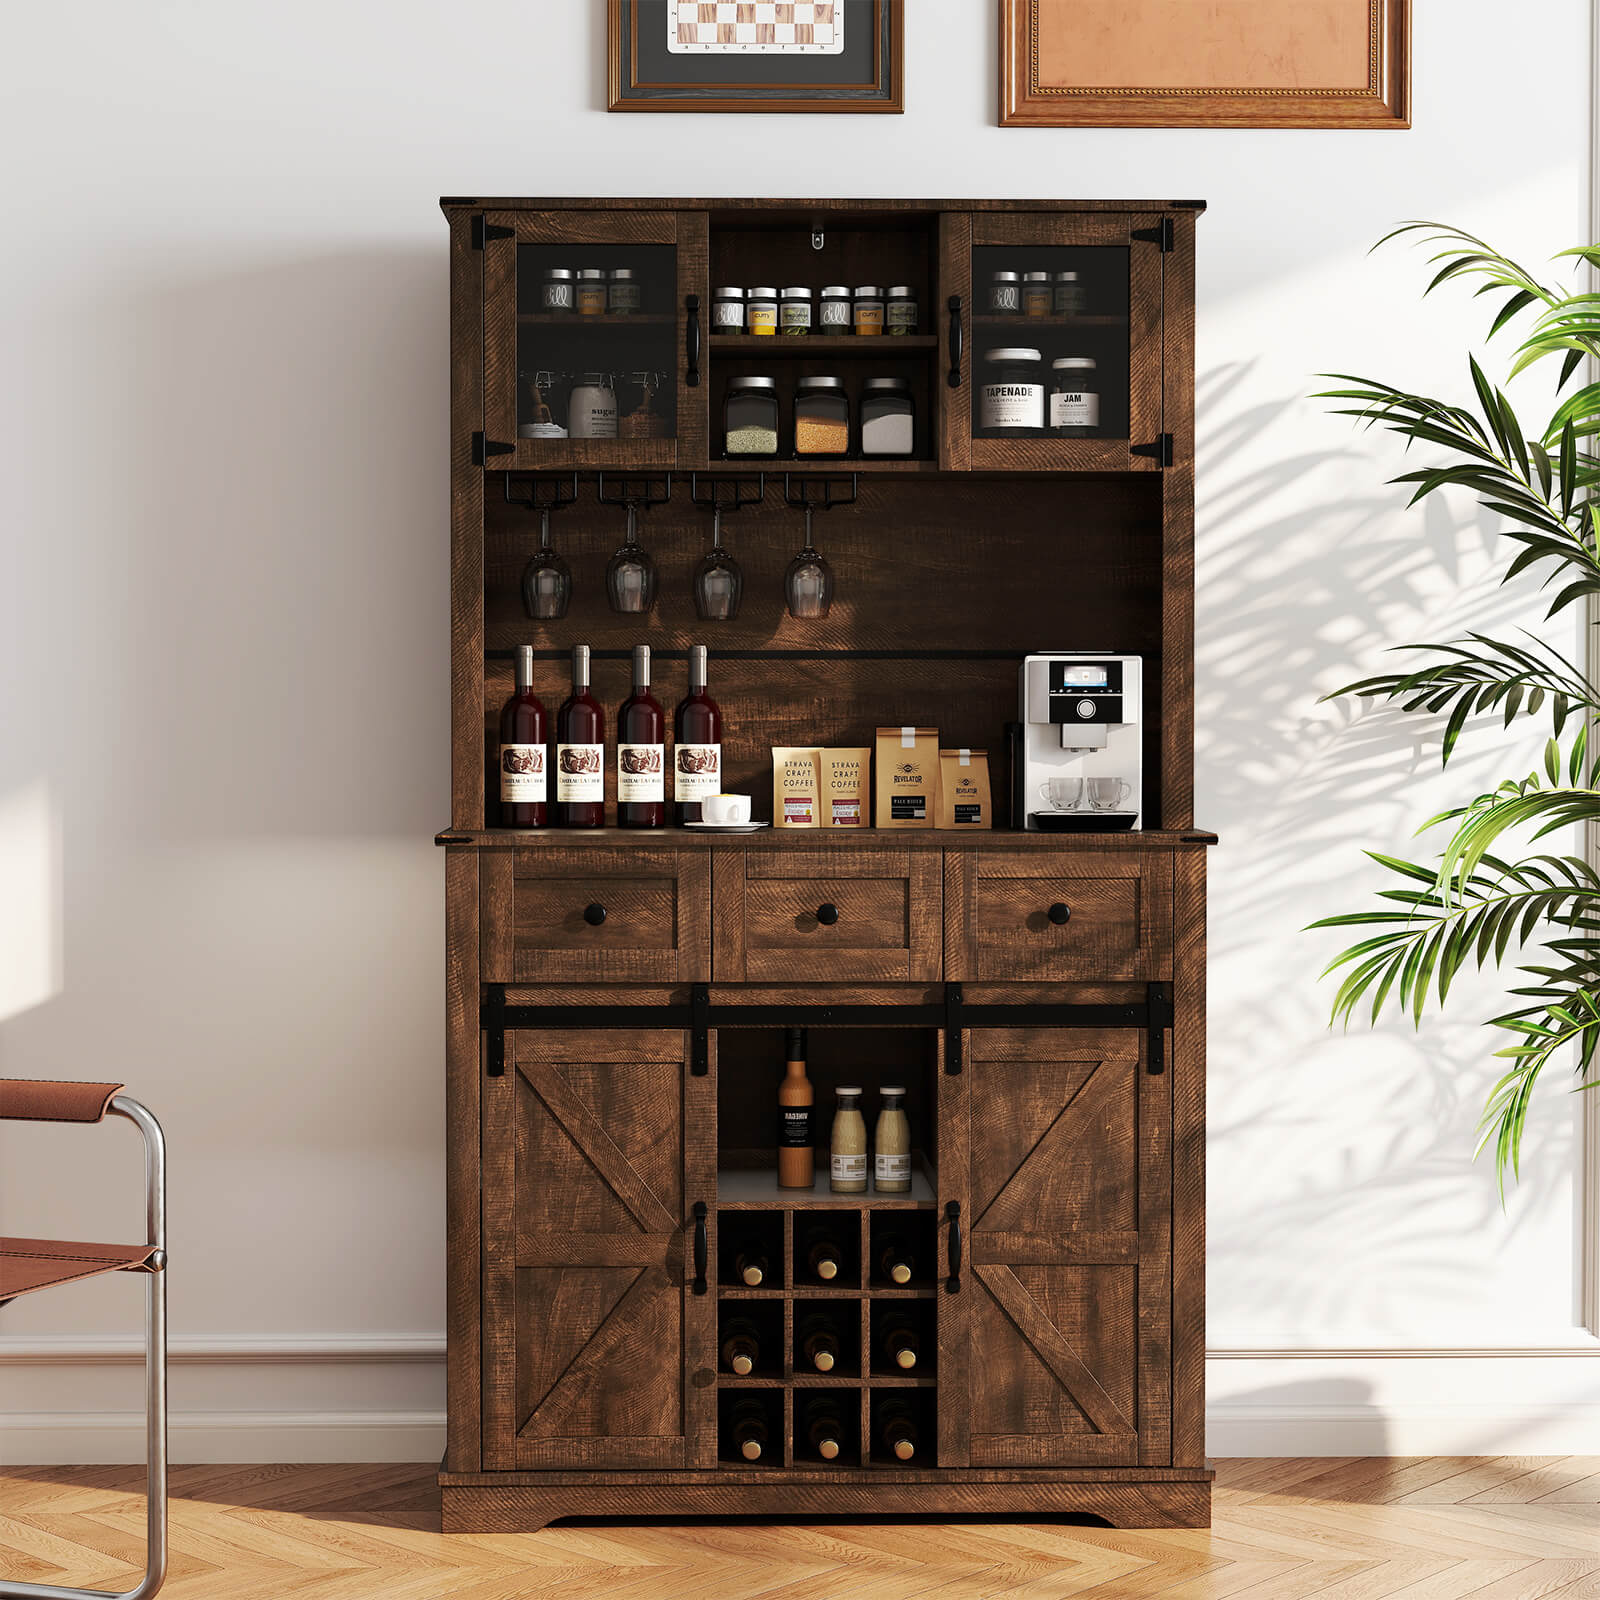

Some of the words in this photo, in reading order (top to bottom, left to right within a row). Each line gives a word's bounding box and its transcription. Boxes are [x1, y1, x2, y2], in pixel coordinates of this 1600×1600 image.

[716, 304, 739, 325] dill
[824, 304, 847, 324] dill
[986, 387, 1033, 397] TAPENADE
[1064, 394, 1082, 402] JAM
[592, 408, 616, 416] sugar
[894, 775, 922, 784] REVELATOR
